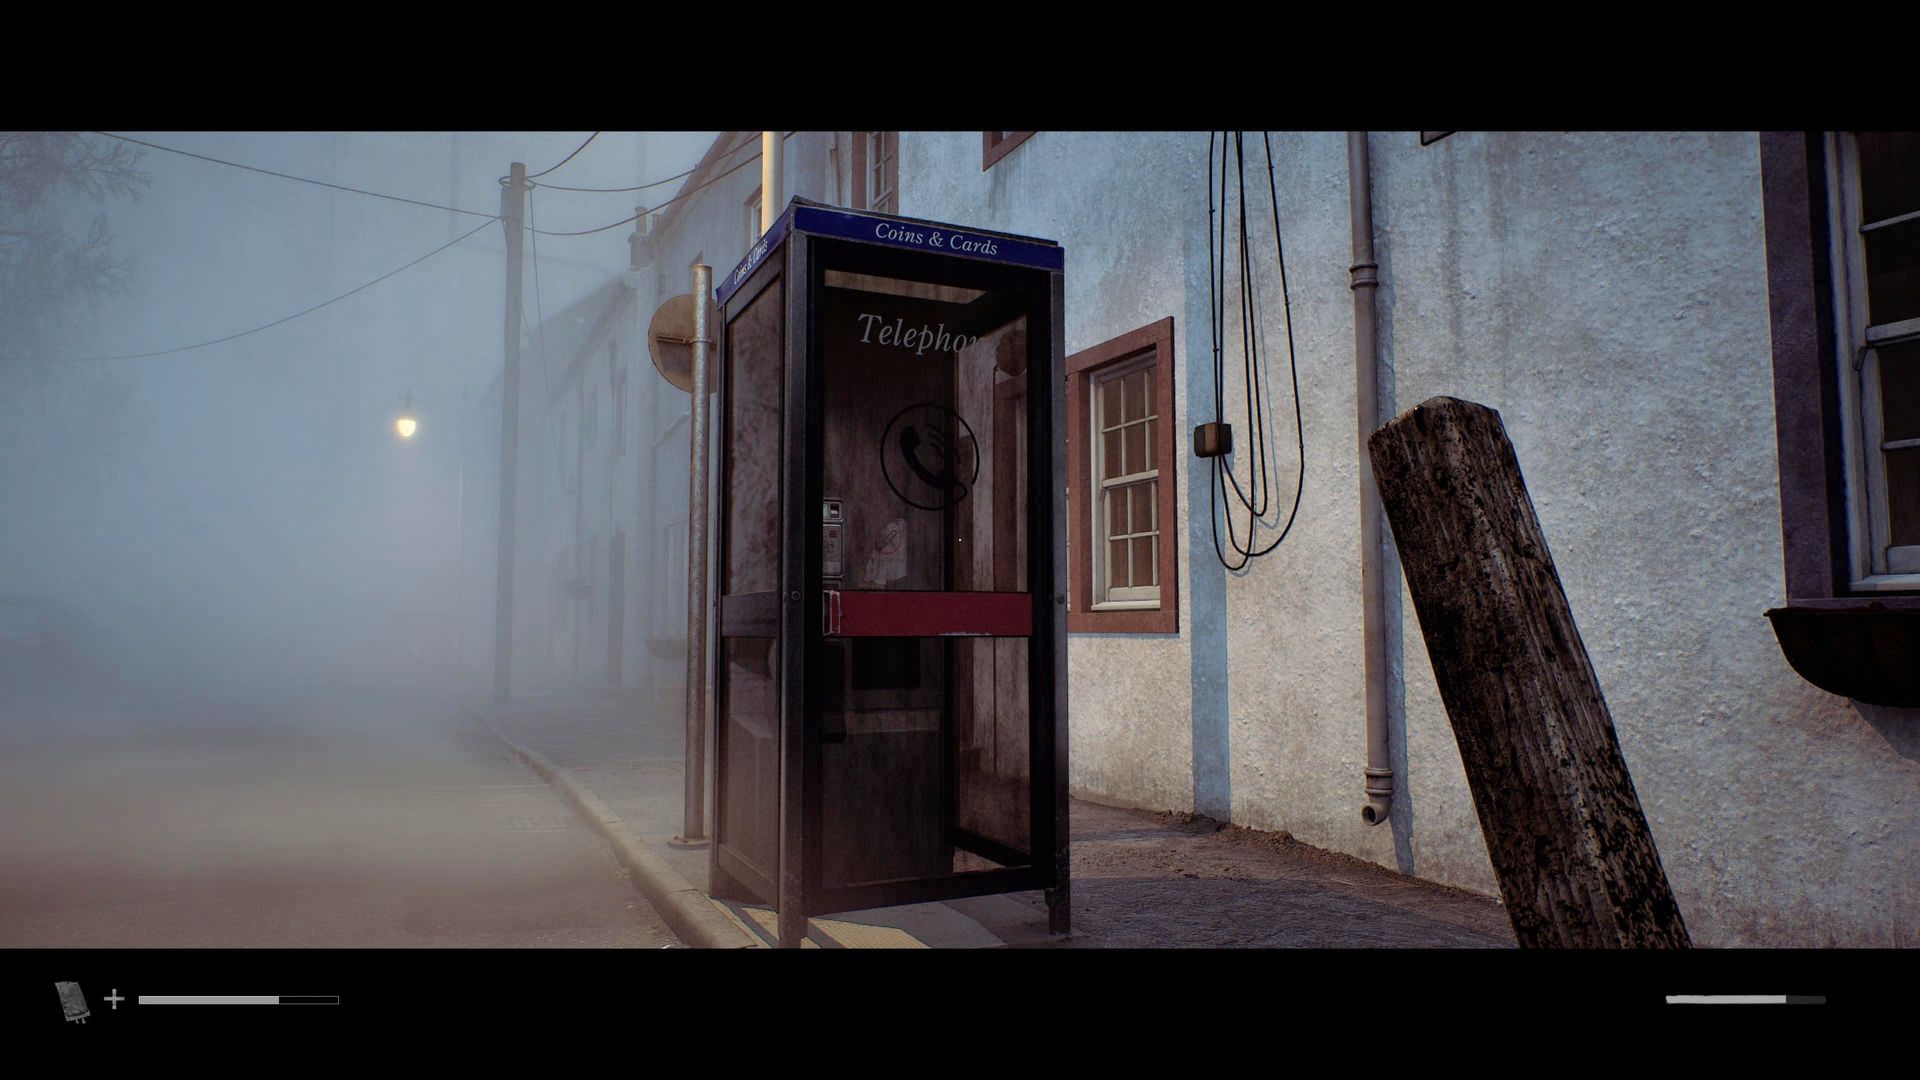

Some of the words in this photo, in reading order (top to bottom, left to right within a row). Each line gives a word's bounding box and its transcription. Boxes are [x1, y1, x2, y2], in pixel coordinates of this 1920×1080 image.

[875, 223, 924, 245] Coins
[928, 231, 944, 247] &
[950, 234, 998, 255] Cards
[733, 263, 747, 285] Coins
[752, 239, 768, 264] Cards
